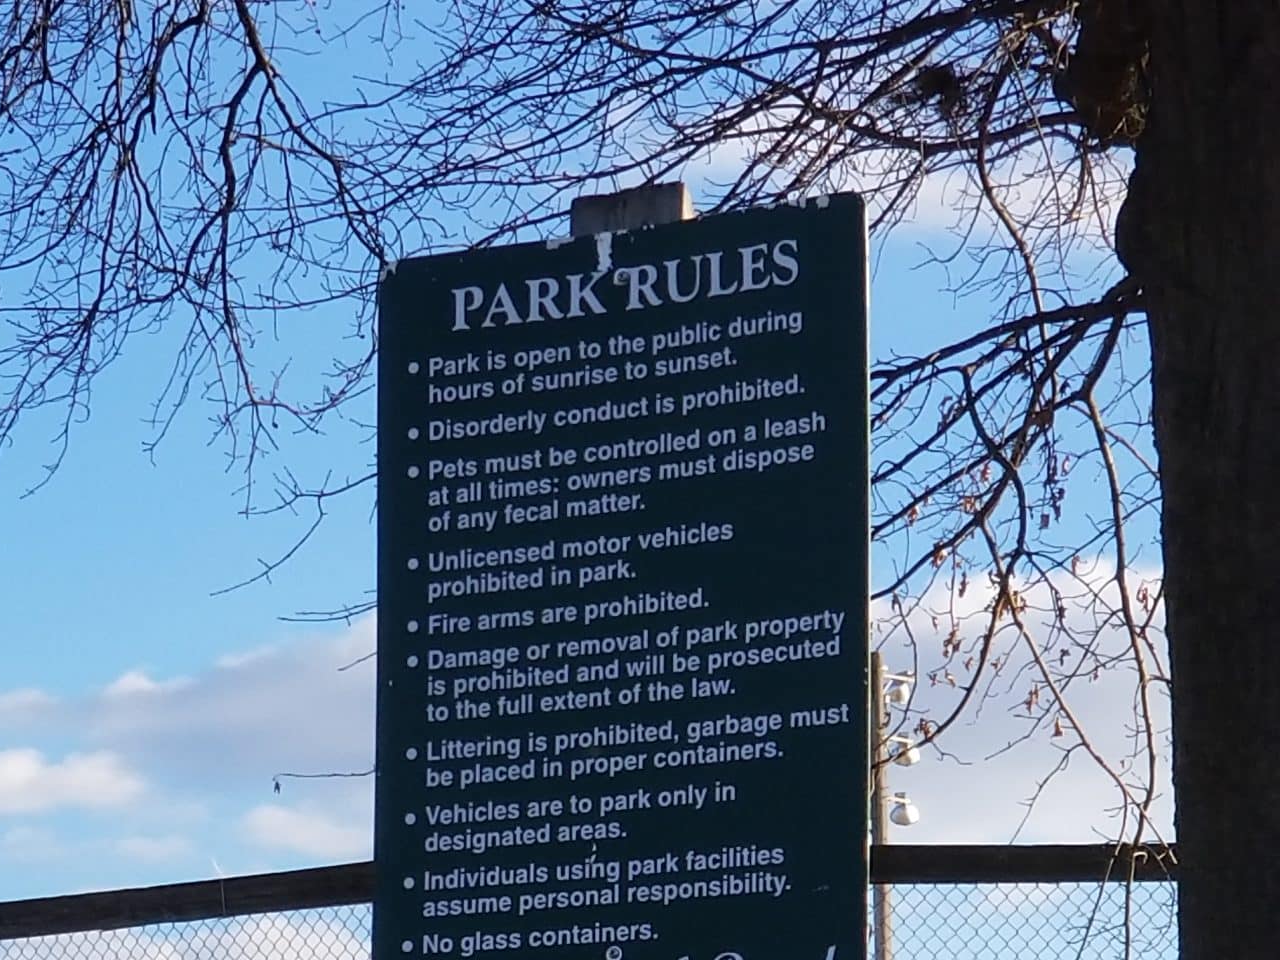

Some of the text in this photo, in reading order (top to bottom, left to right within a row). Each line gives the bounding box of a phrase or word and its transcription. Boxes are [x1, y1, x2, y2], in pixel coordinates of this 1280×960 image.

[451, 240, 800, 331] PARK RULES
[429, 312, 802, 377] Park is open to the public during
[429, 347, 737, 403] hours of sunrise to sunset.
[429, 374, 804, 440] Disorderly conduct is prohibited.
[429, 412, 825, 480] Pets must be controlled on a leash
[429, 486, 449, 506] at
[456, 482, 481, 503] all
[567, 467, 651, 490] owners
[659, 455, 715, 480] must
[723, 445, 814, 472] dispose
[429, 494, 645, 532] of any fecal matter.
[429, 523, 733, 571] Unlicensed motor vehicles
[428, 559, 636, 603] prohibited in park.
[429, 588, 709, 634] Fire arms are prohibited.
[428, 610, 844, 669] Damage or removal of park property
[428, 635, 839, 698] is prohibited and will be prosecuted
[427, 678, 735, 721] to the full extent of the law.
[427, 704, 849, 761] Littering is prohibited, garbage must
[426, 741, 783, 789] be placed in proper containers.
[426, 781, 735, 825] Vehicles are to park only in
[425, 822, 626, 853] designated areas.
[424, 845, 784, 890] Individuals using park facilities
[423, 872, 791, 917] assume personal responsibility.
[423, 922, 658, 957] No glass containers.
